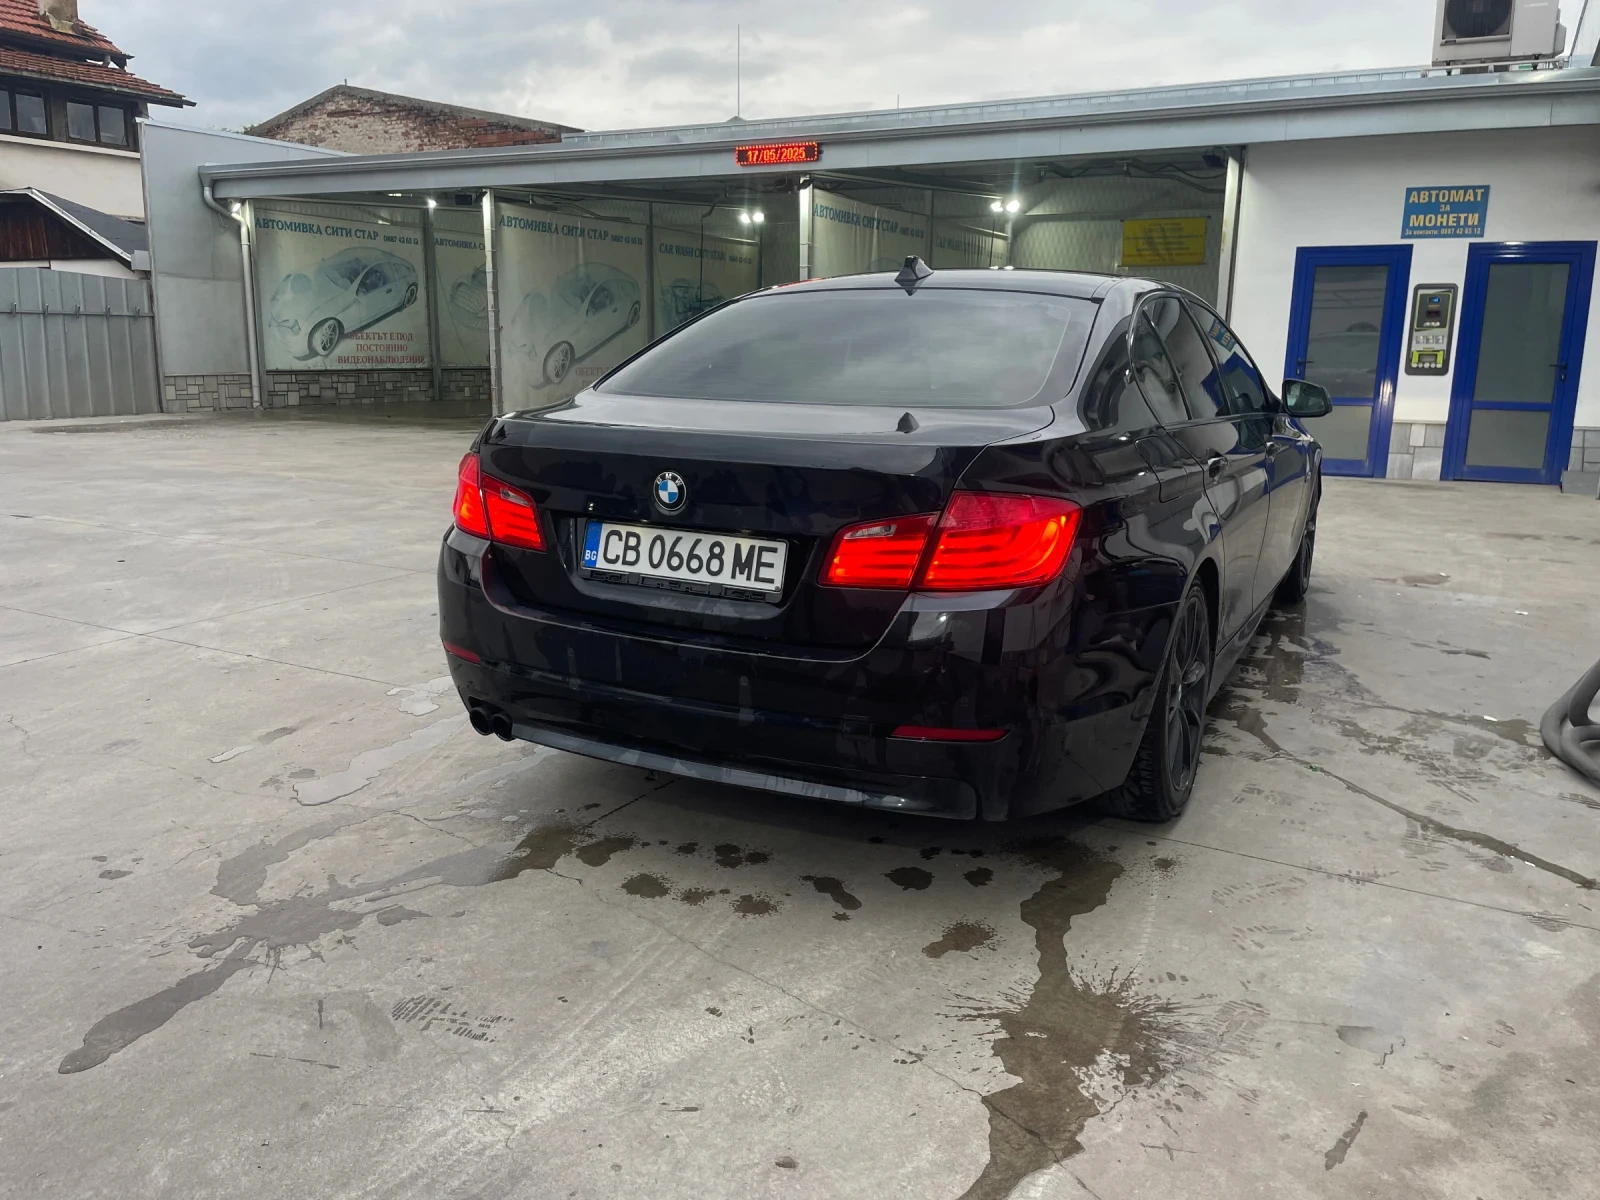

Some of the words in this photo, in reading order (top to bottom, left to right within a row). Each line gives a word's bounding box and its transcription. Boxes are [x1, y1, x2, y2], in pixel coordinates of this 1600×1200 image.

[747, 147, 806, 162] 17/05/2025
[1409, 189, 1484, 203] АВТОМАТ
[1440, 204, 1450, 212] ЗА
[813, 203, 860, 226] АВТОМИВКА
[882, 219, 898, 233] СТАР
[1409, 213, 1479, 227] МОНЕТИ
[255, 217, 322, 235] АВТОМИВКА
[325, 225, 352, 238] СИТИ
[355, 229, 379, 241] СТАР
[499, 214, 559, 235] АВТОМИВКА
[561, 224, 585, 238] СИТИ
[587, 228, 609, 241] СТАР
[435, 237, 477, 250] АВТОМИВКА
[659, 243, 674, 255] CAR
[675, 245, 694, 258] WASH
[694, 248, 709, 259] CTY
[390, 332, 394, 340] Е
[396, 332, 413, 341] ПОД
[356, 343, 408, 352] ПОСТОЯННО
[337, 355, 425, 364] ВИДЕОНАБЛЮДЕНИЕ
[656, 473, 683, 486] BMW
[584, 549, 597, 561] BG
[602, 529, 641, 567] CB
[648, 534, 725, 577] 0668
[731, 542, 778, 584] ME
